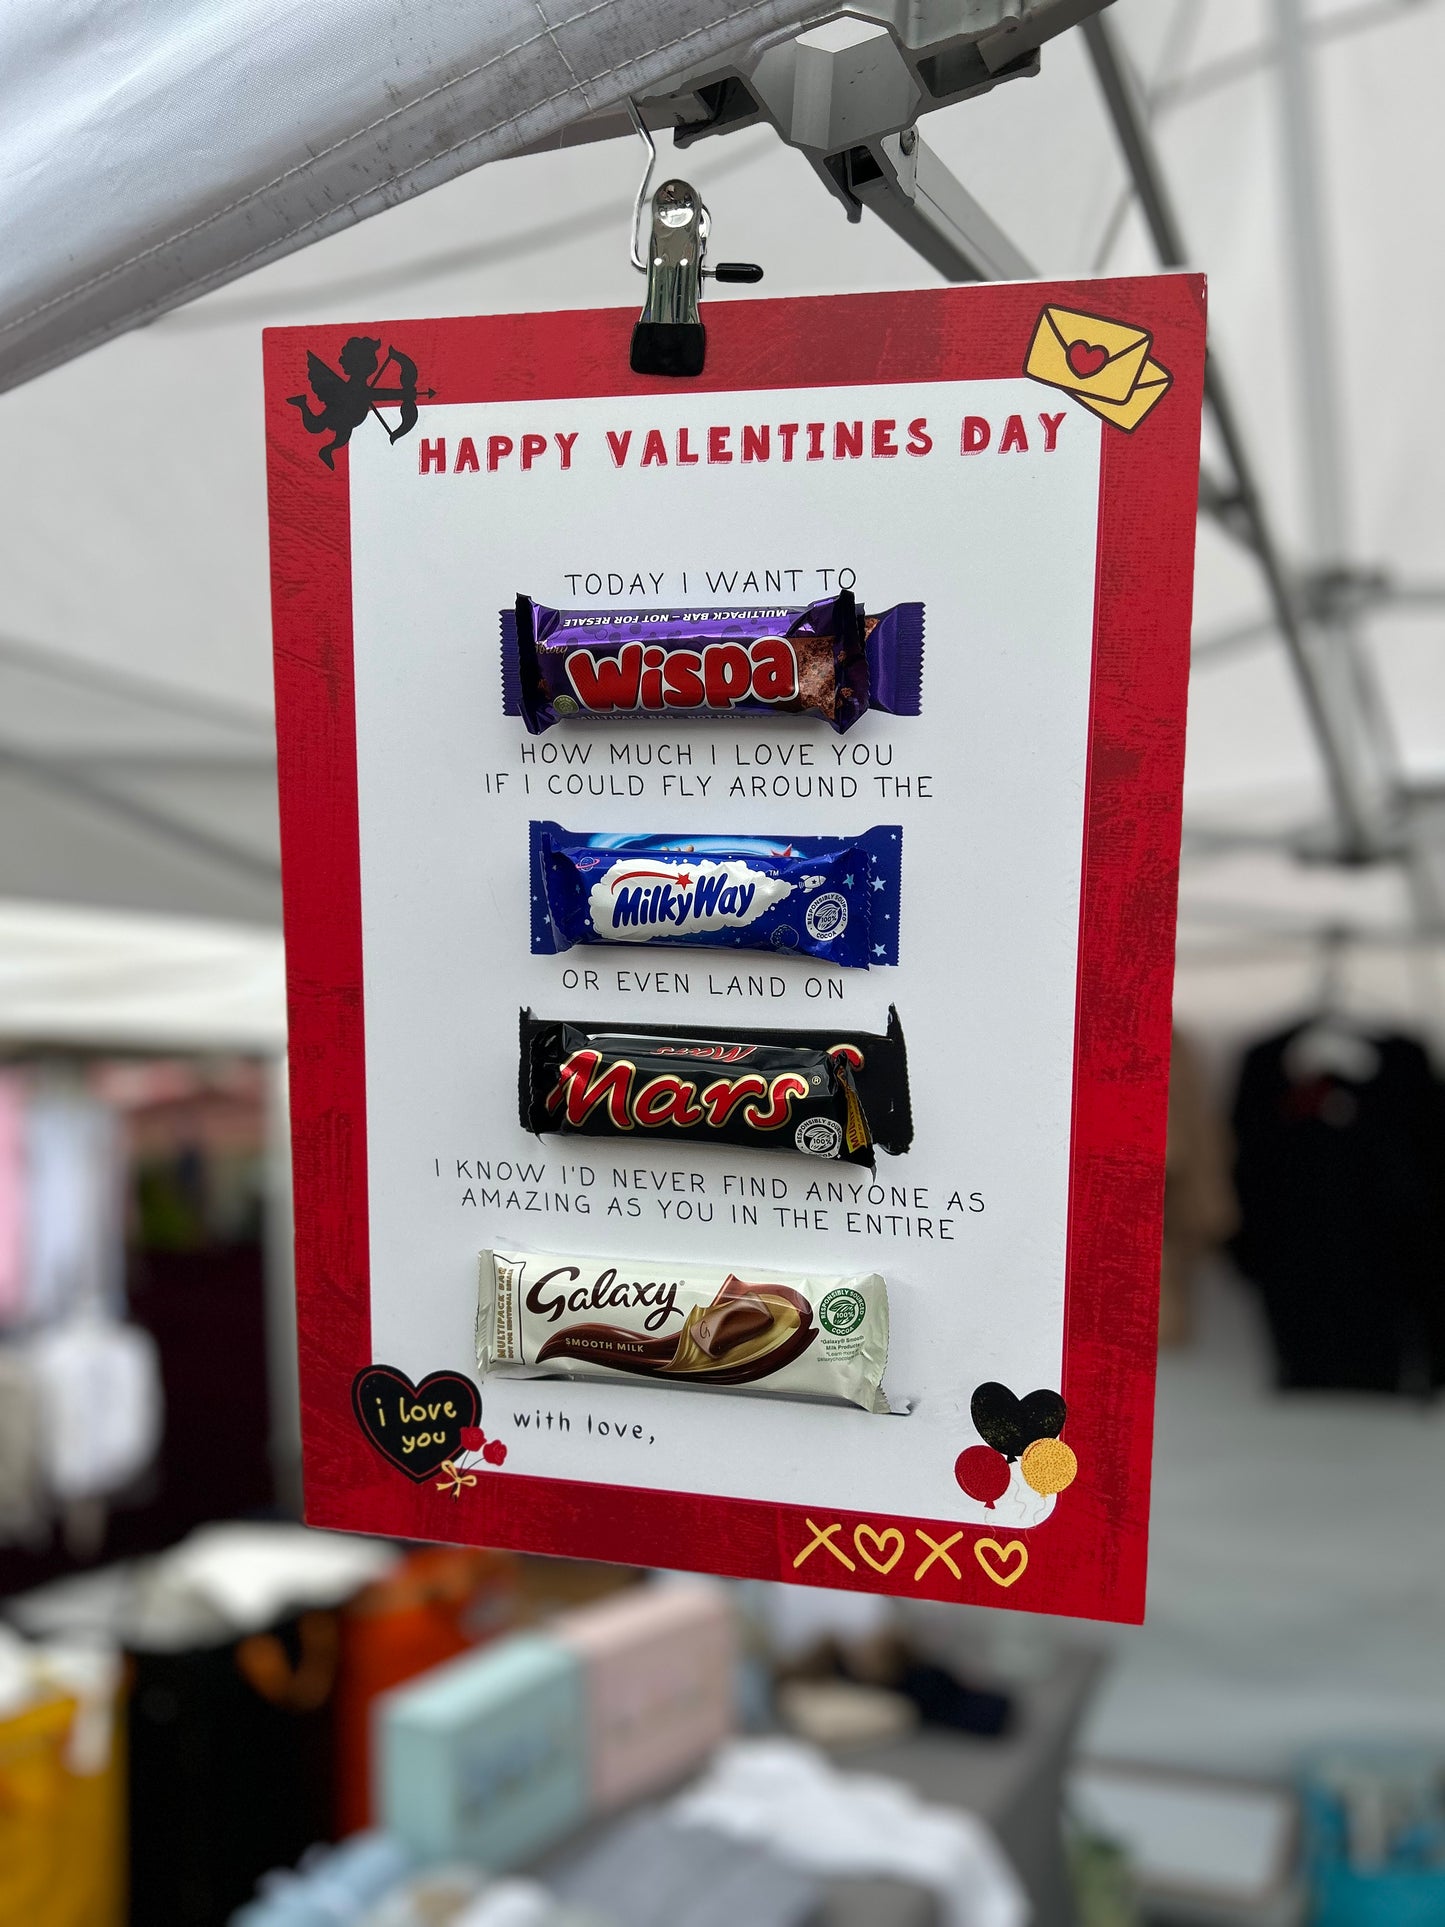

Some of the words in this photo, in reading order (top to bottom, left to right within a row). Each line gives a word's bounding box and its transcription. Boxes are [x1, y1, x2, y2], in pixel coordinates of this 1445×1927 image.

[419, 433, 578, 475] HAPPY
[606, 418, 932, 468] VALENTINES
[961, 413, 1066, 456] DAY
[564, 573, 664, 595] TODAY
[706, 570, 803, 593] WANT
[816, 568, 856, 592] TO
[563, 617, 610, 627] RESALE
[614, 615, 639, 624] FOR
[642, 614, 669, 623] NOT
[683, 612, 710, 621] BAR
[713, 609, 788, 621] MULTIPACK
[567, 637, 798, 711] Wispa
[521, 743, 592, 764] HOW
[610, 744, 691, 765] MUCH
[736, 744, 813, 765] LOVE
[832, 744, 892, 765] YOU
[486, 773, 509, 793] IF
[548, 774, 643, 796] COULD
[663, 775, 711, 796] FLY
[730, 776, 857, 797] AROUND
[874, 776, 932, 797] THE
[816, 931, 837, 939] COCOA
[563, 970, 599, 990] OR
[617, 971, 688, 993] EVEN
[709, 975, 785, 997] LAND
[805, 978, 843, 999] ON
[650, 1046, 757, 1063] Mars
[457, 1160, 545, 1182] KNOW
[563, 1166, 594, 1186] I'D
[613, 1169, 705, 1193] NEVER
[724, 1176, 787, 1198] FIND
[804, 1181, 928, 1210] ANYONE
[947, 1192, 984, 1212] AS
[462, 1185, 590, 1213] AMAZING
[608, 1197, 641, 1216] AS
[658, 1200, 712, 1221] YOU
[732, 1205, 757, 1225] IN
[773, 1208, 828, 1230] THE
[847, 1213, 954, 1239] ENTIRE
[526, 1266, 684, 1331] Galaxy
[497, 1295, 507, 1358] MULTIPACK
[831, 1327, 854, 1335] COCOA
[565, 1337, 612, 1350] SMOOTH
[617, 1342, 644, 1353] MILK
[399, 1397, 457, 1423] love
[514, 1410, 570, 1431] with
[588, 1415, 654, 1444] love,
[402, 1431, 446, 1454] you
